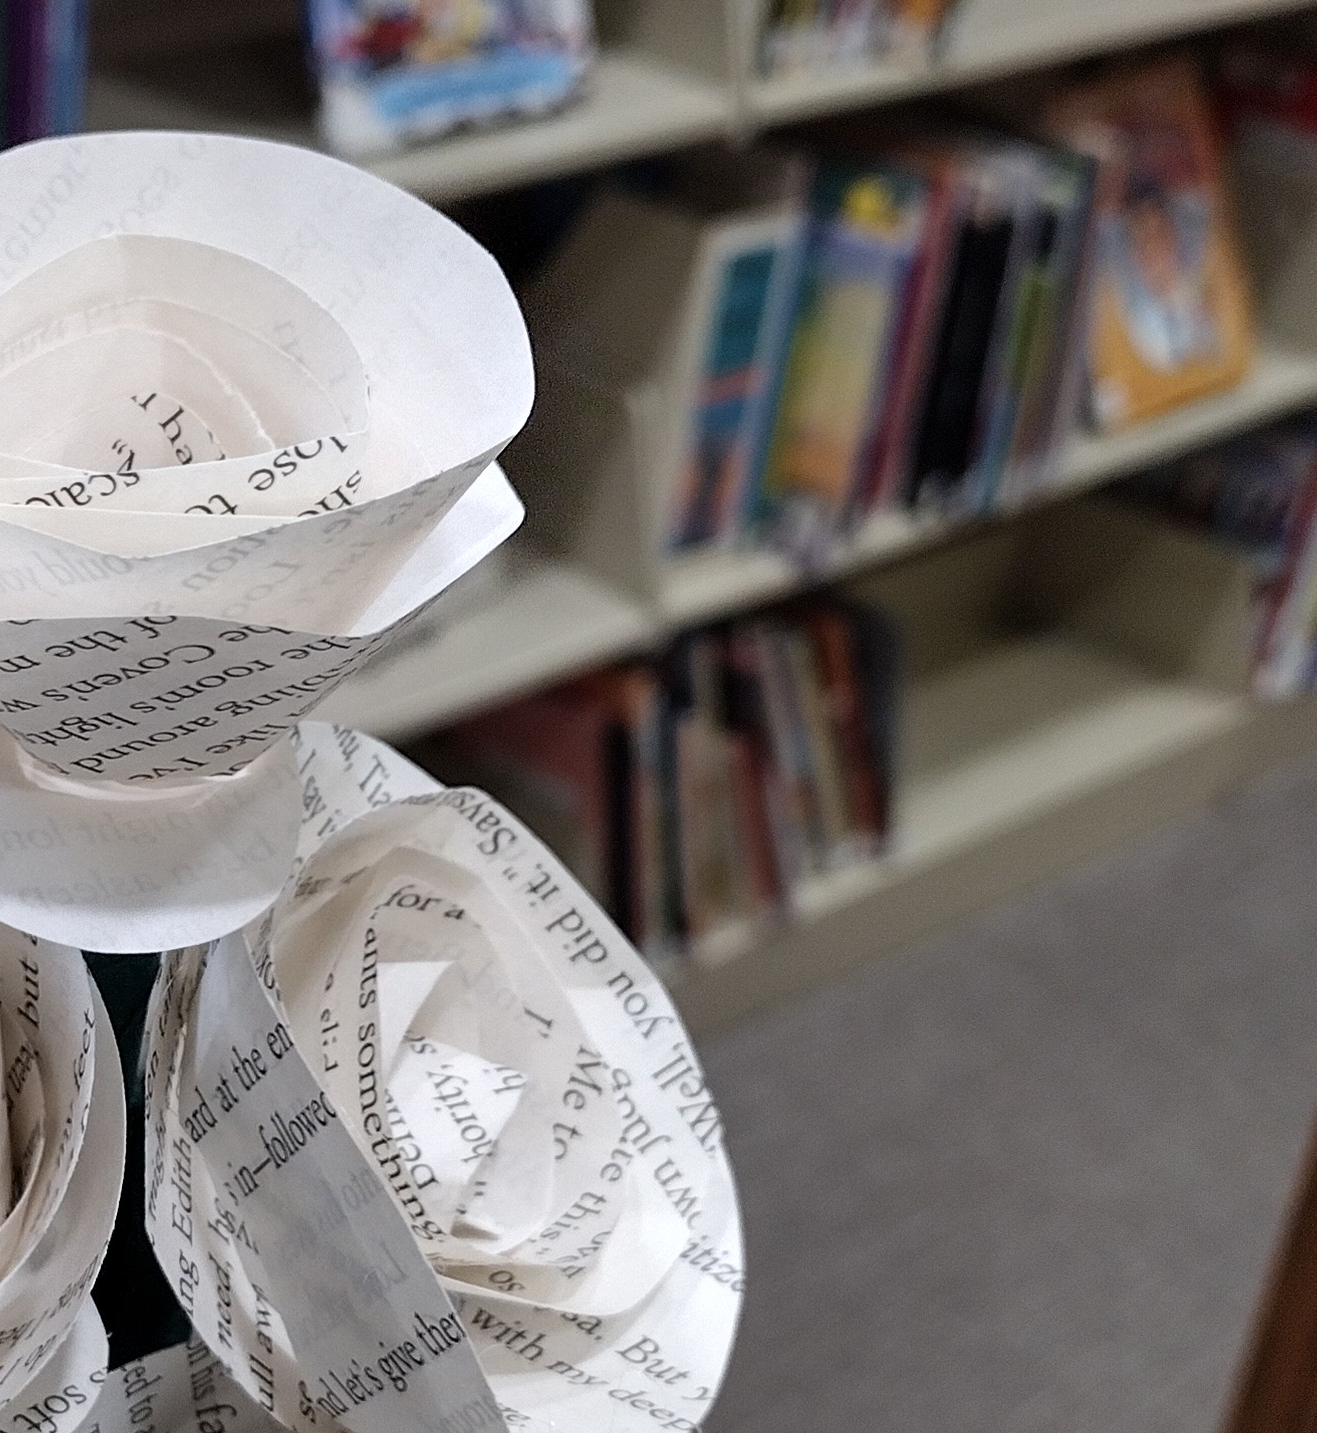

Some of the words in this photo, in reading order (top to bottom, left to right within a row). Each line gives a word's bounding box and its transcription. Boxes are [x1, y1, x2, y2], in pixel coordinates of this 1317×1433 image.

[41, 644, 216, 702] Coven's
[45, 630, 128, 658] the
[129, 659, 275, 714] room's
[70, 715, 219, 774] around
[383, 883, 443, 912] for
[544, 906, 610, 966] did
[606, 970, 674, 1040] you
[215, 1072, 239, 1113] at
[230, 1044, 268, 1092] the
[329, 1358, 384, 1406] let's
[376, 1340, 426, 1394] give
[470, 1306, 547, 1363] with
[546, 1359, 609, 1388] my
[614, 1334, 692, 1387] But
